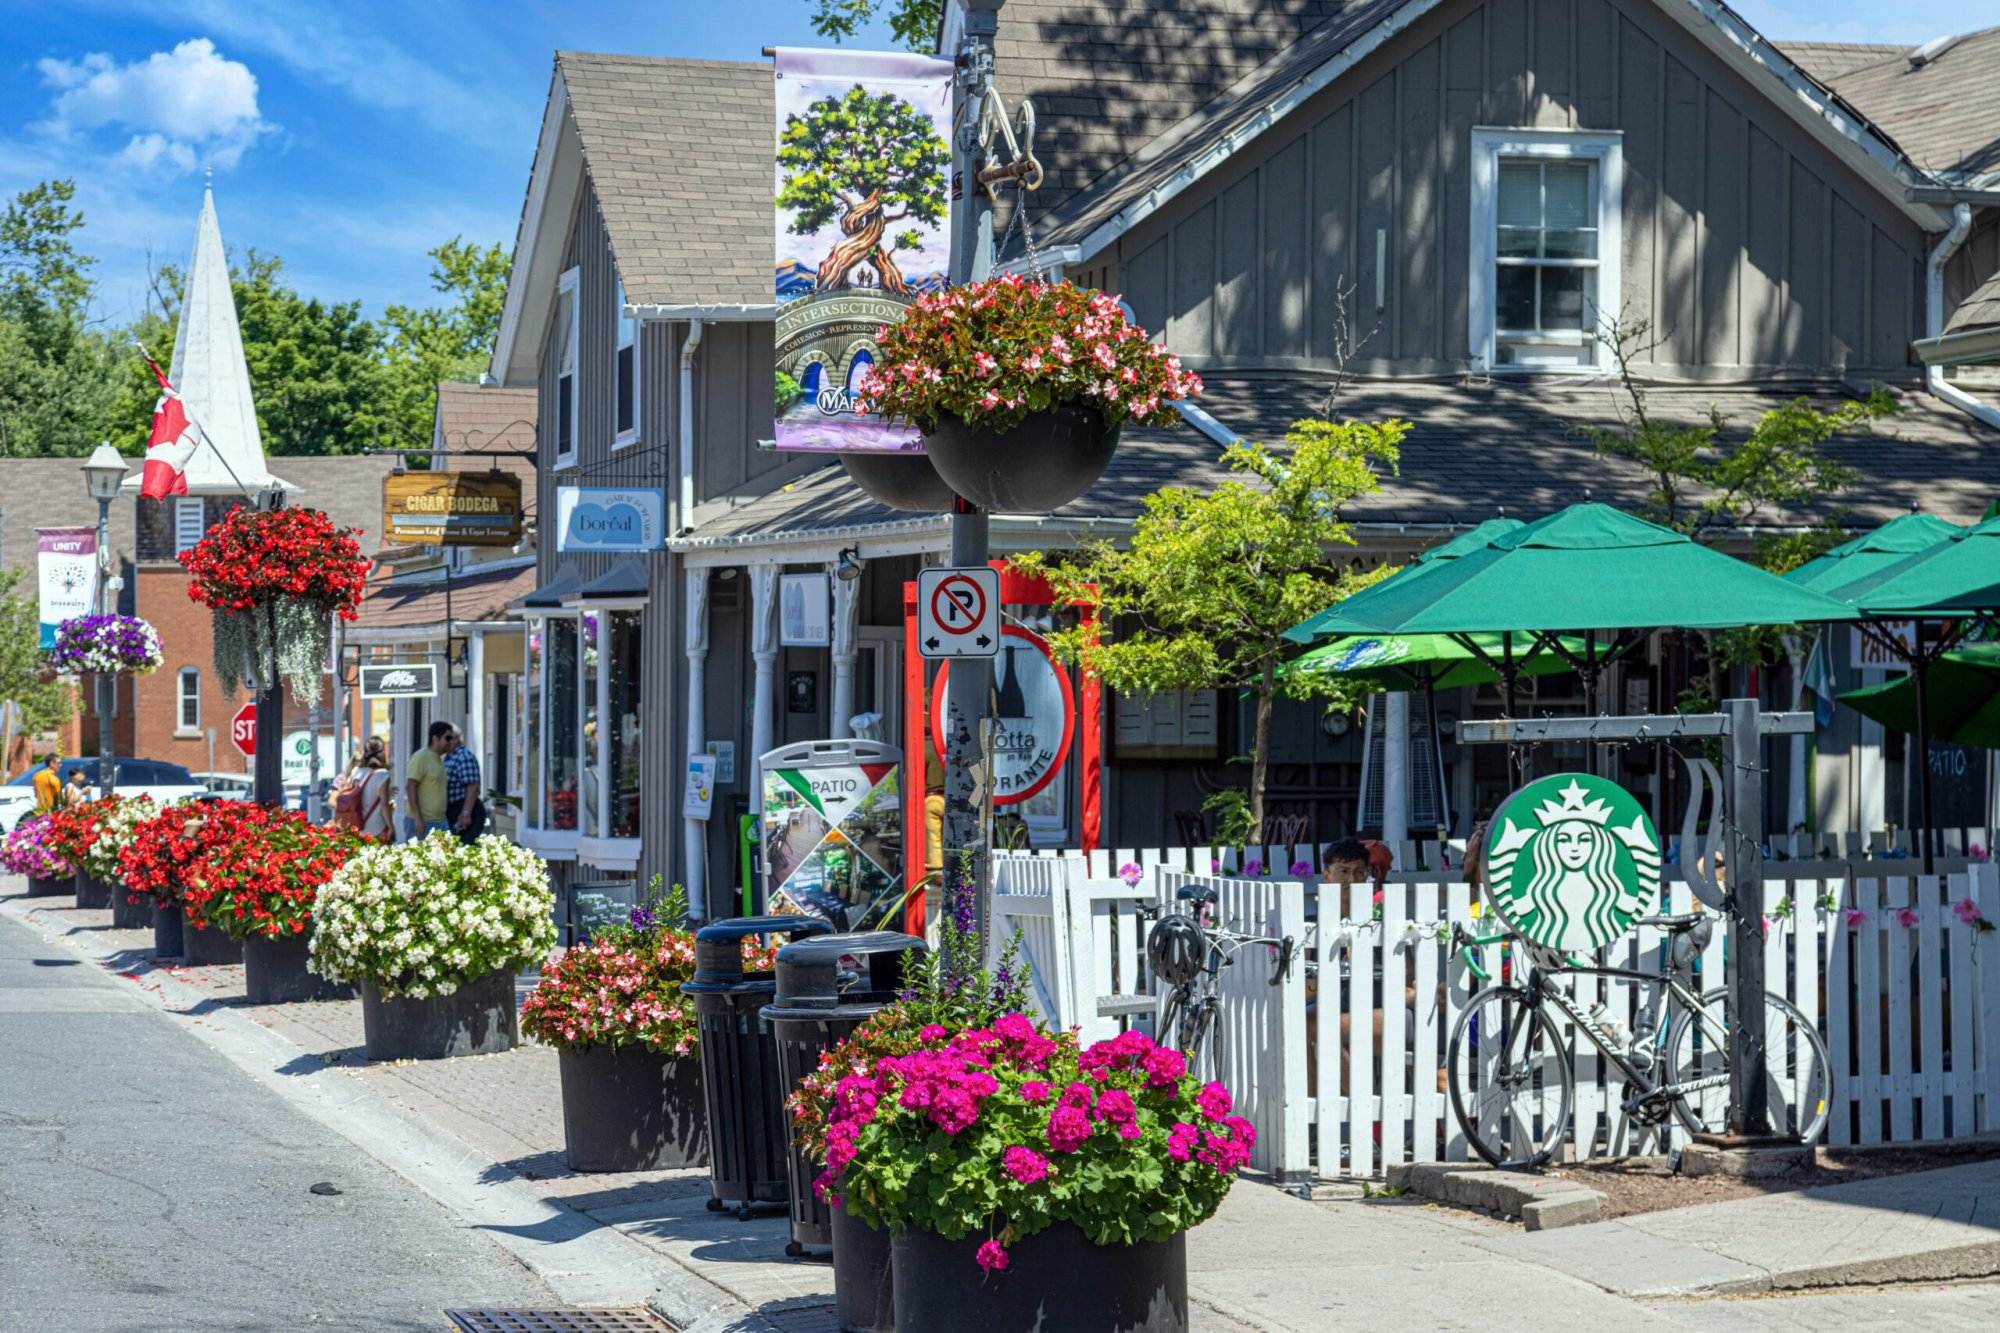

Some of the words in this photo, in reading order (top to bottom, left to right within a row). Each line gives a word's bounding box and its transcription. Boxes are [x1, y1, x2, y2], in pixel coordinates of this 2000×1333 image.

[406, 495, 445, 512] CIGAR
[448, 496, 499, 512] BODEGA
[52, 542, 82, 551] UNITY
[235, 720, 257, 740] ST
[811, 779, 857, 793] PATIO
